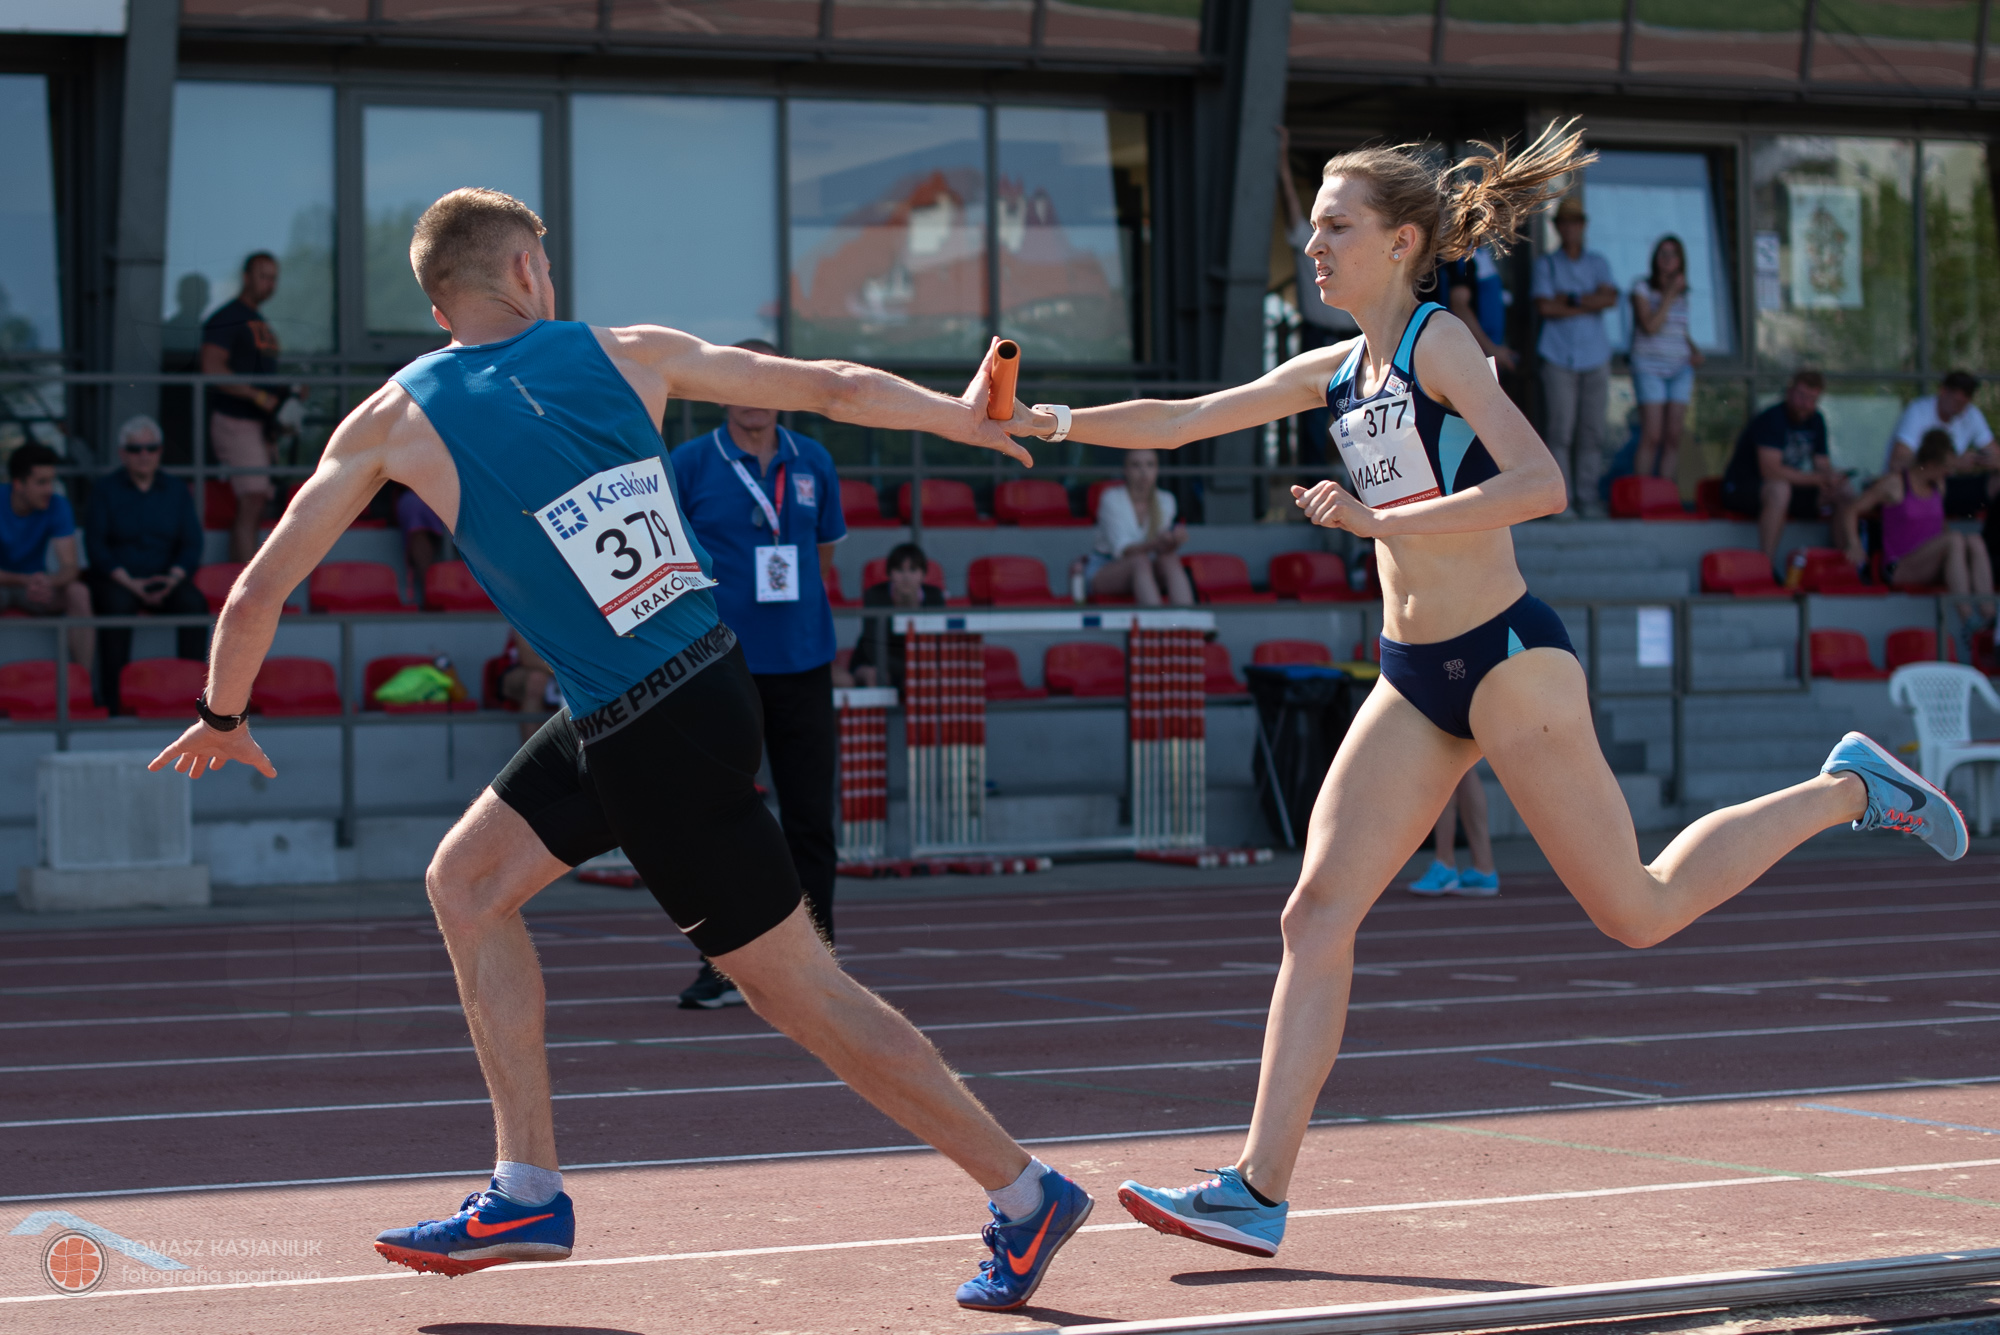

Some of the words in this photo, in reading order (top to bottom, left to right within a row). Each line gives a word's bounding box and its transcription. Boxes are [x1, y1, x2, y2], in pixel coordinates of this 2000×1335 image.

[1363, 399, 1408, 438] 377
[587, 471, 660, 513] Kraków
[1352, 456, 1403, 492] MAŁEK
[595, 508, 676, 581] 379
[574, 696, 629, 741] NIKE
[625, 655, 687, 712] PRO
